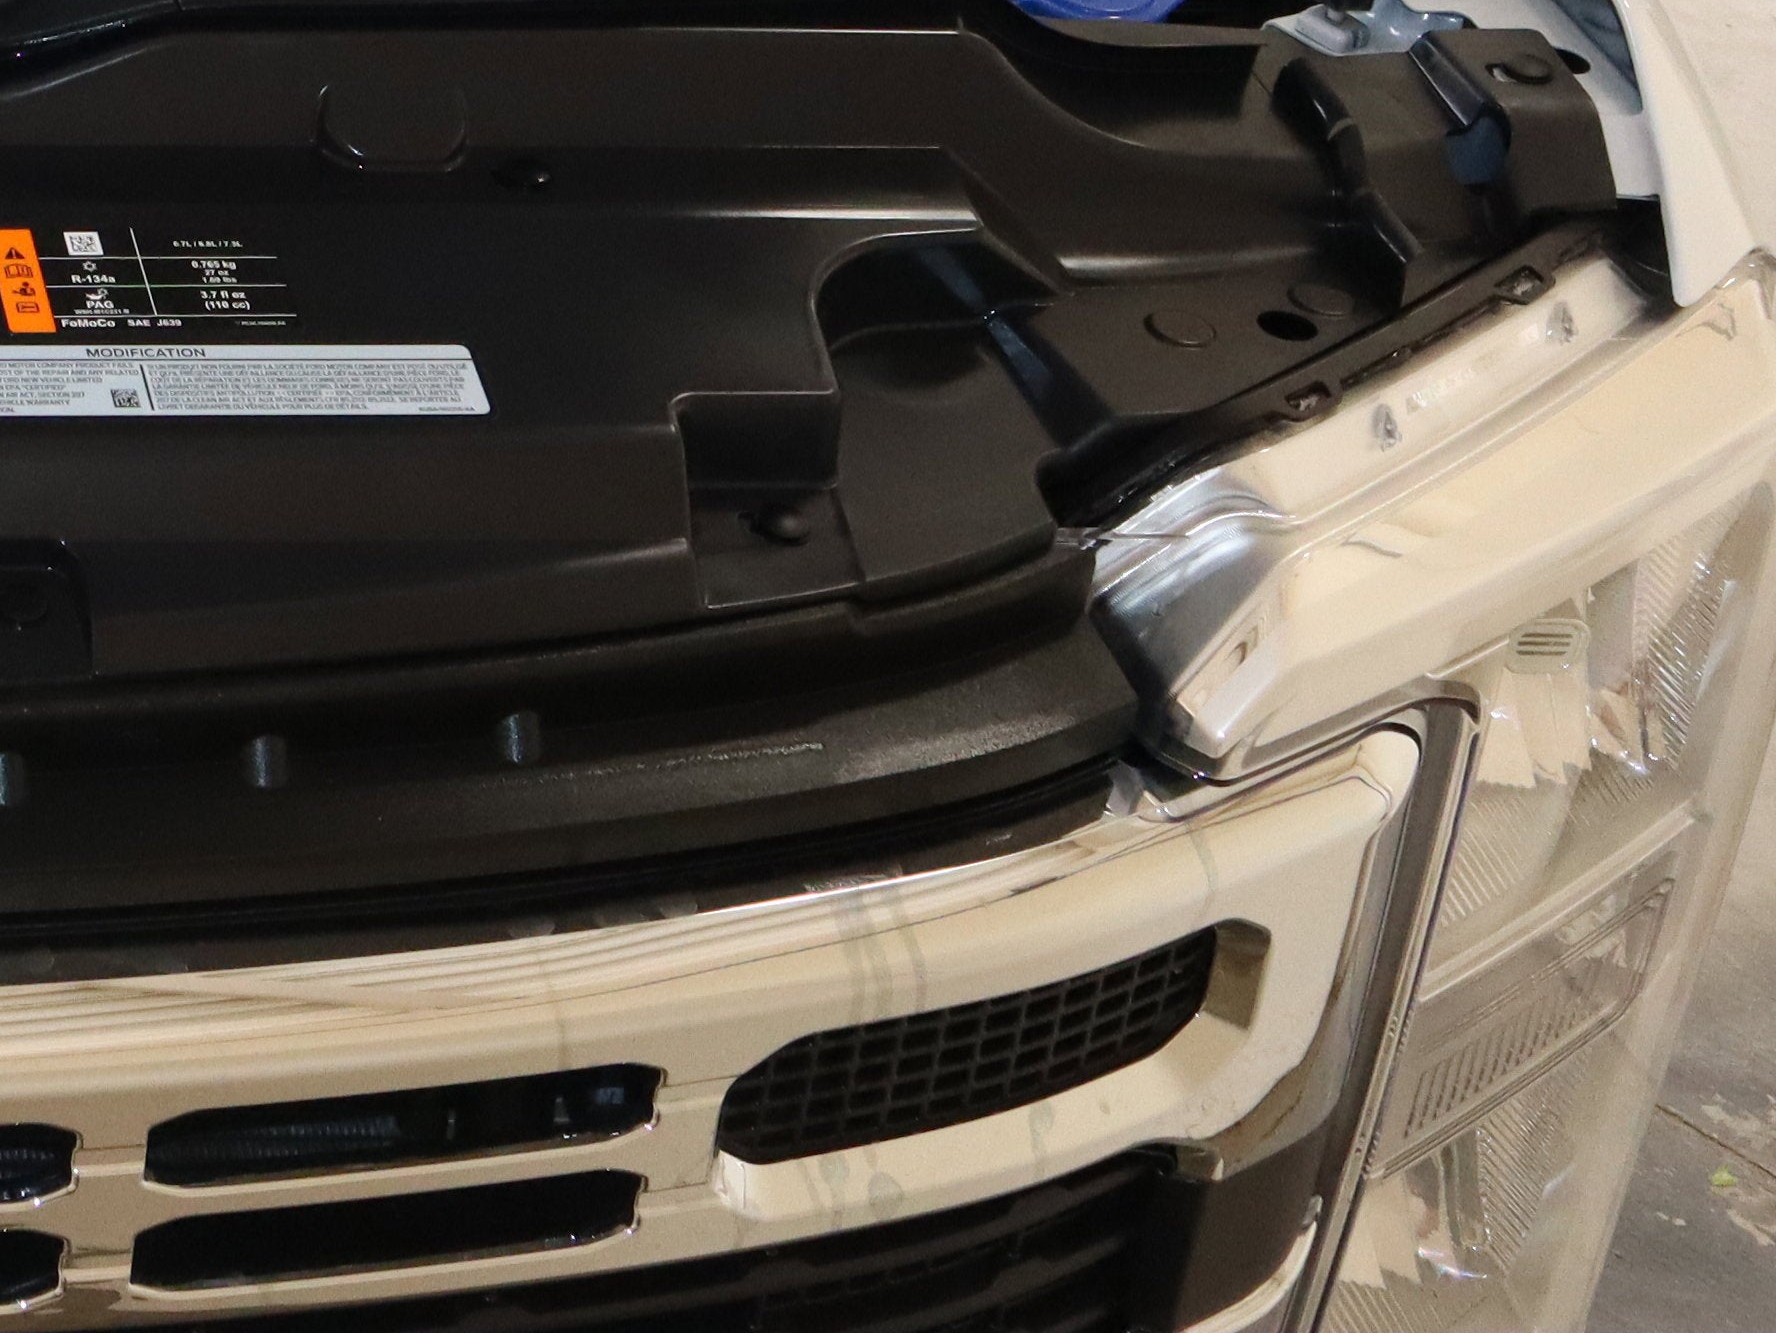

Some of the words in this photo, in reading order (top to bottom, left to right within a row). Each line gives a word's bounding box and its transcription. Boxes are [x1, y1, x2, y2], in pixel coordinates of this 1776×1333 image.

[191, 260, 220, 269] 0.765
[222, 260, 236, 270] kg
[71, 275, 116, 283] R-134a
[200, 291, 218, 299] 3.7
[85, 301, 114, 309] PAG
[232, 301, 250, 310] cc)
[61, 319, 116, 328] FoMoCo
[127, 319, 151, 327] SAE
[156, 319, 182, 327] J639
[85, 348, 207, 358] MODIFICATION
